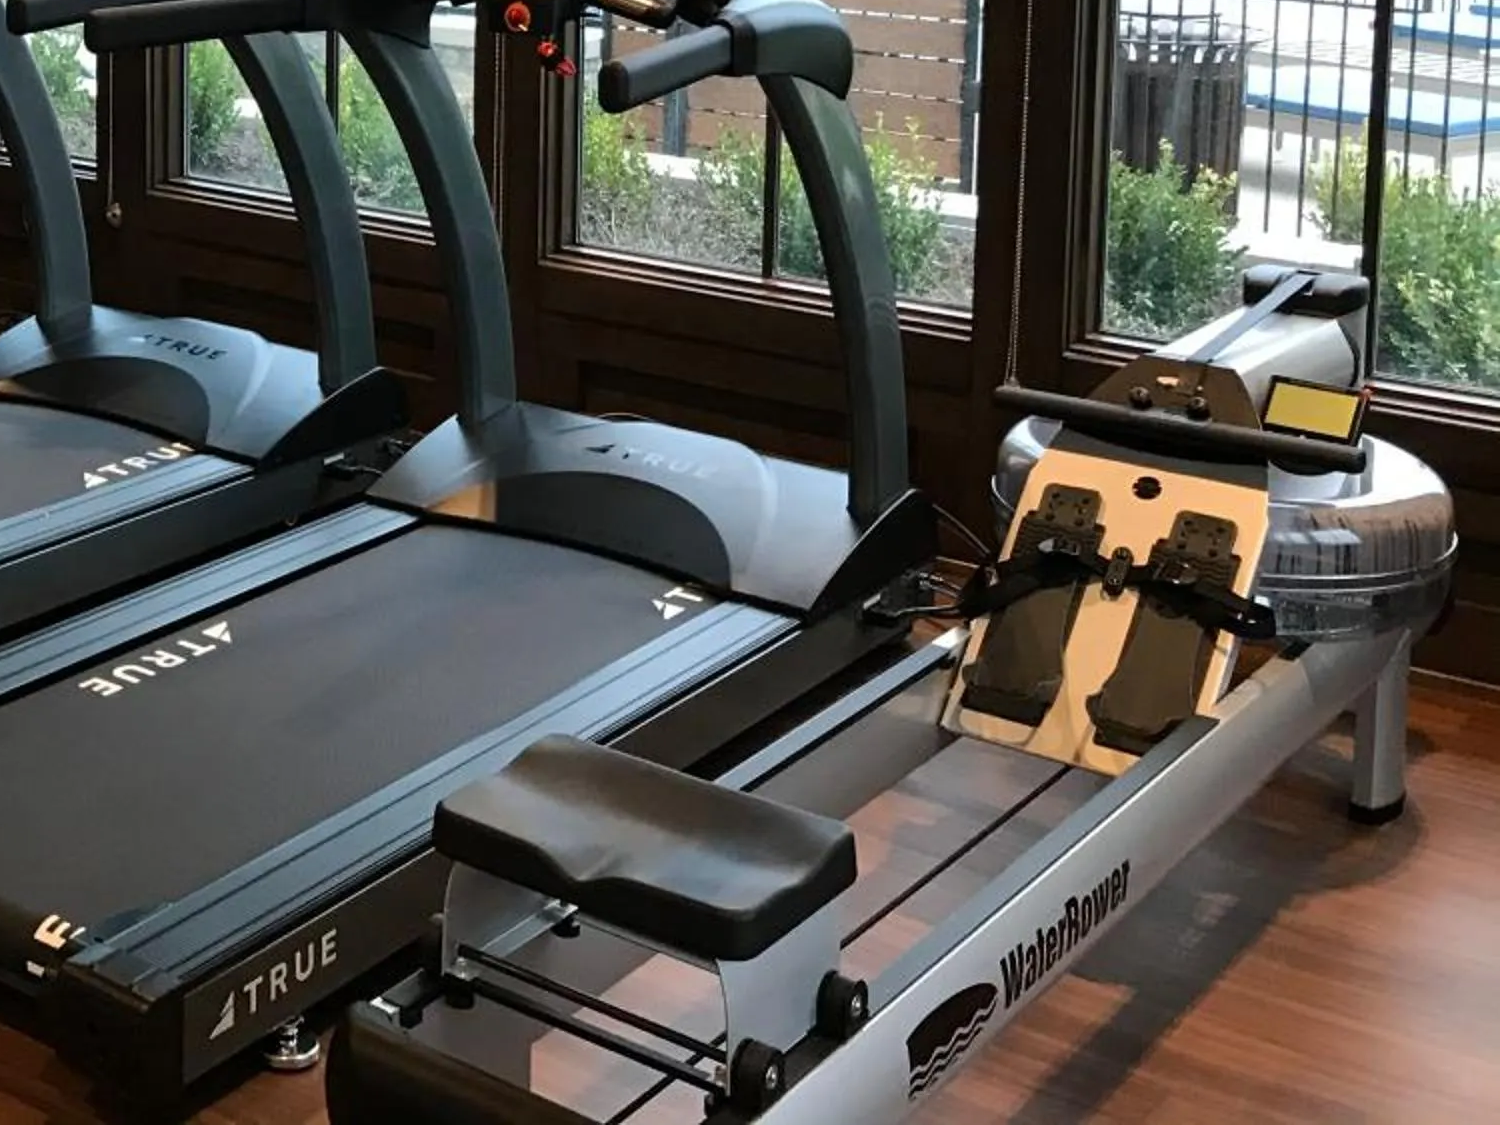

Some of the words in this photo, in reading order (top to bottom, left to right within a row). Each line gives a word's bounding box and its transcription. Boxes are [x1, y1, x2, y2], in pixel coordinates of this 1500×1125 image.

[155, 336, 229, 360] TRUE
[77, 640, 217, 697] TRUE
[999, 858, 1131, 1010] WaterRower
[243, 928, 338, 1015] TRUE
